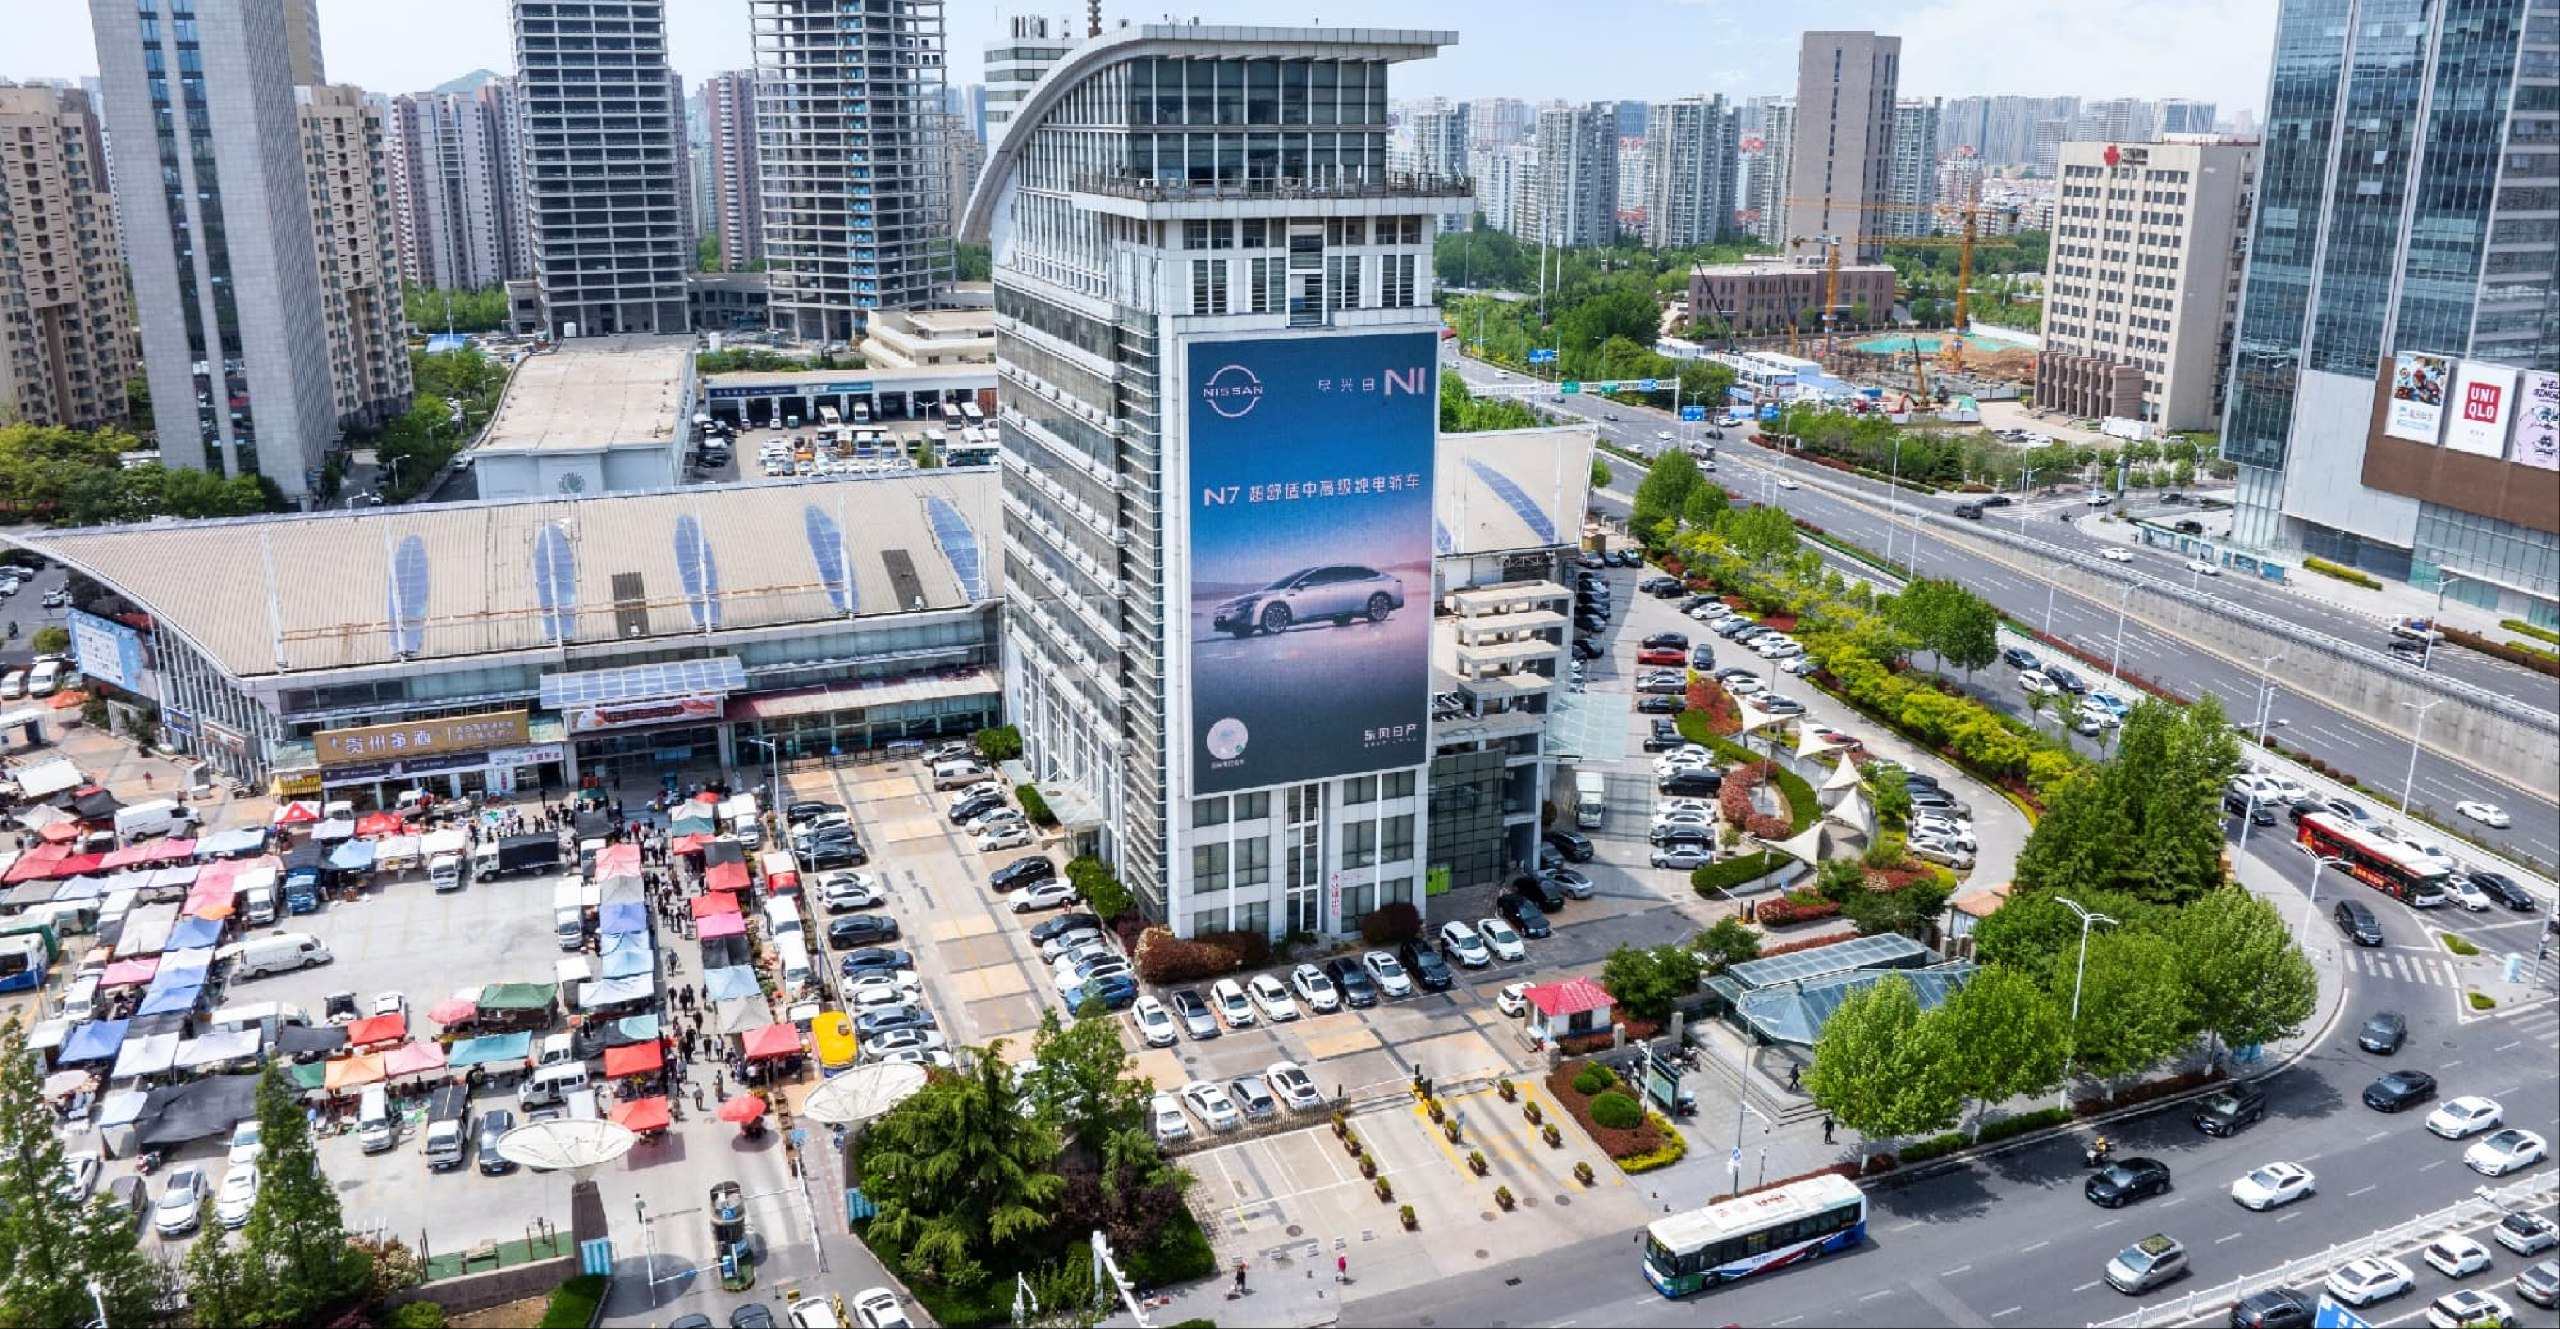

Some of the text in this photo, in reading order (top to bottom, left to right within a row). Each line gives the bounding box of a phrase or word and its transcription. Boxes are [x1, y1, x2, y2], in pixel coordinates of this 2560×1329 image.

[1203, 386, 1263, 398] NISSAN
[2470, 386, 2497, 402] UNI
[2468, 402, 2495, 419] QLO
[1203, 486, 1241, 507] N7
